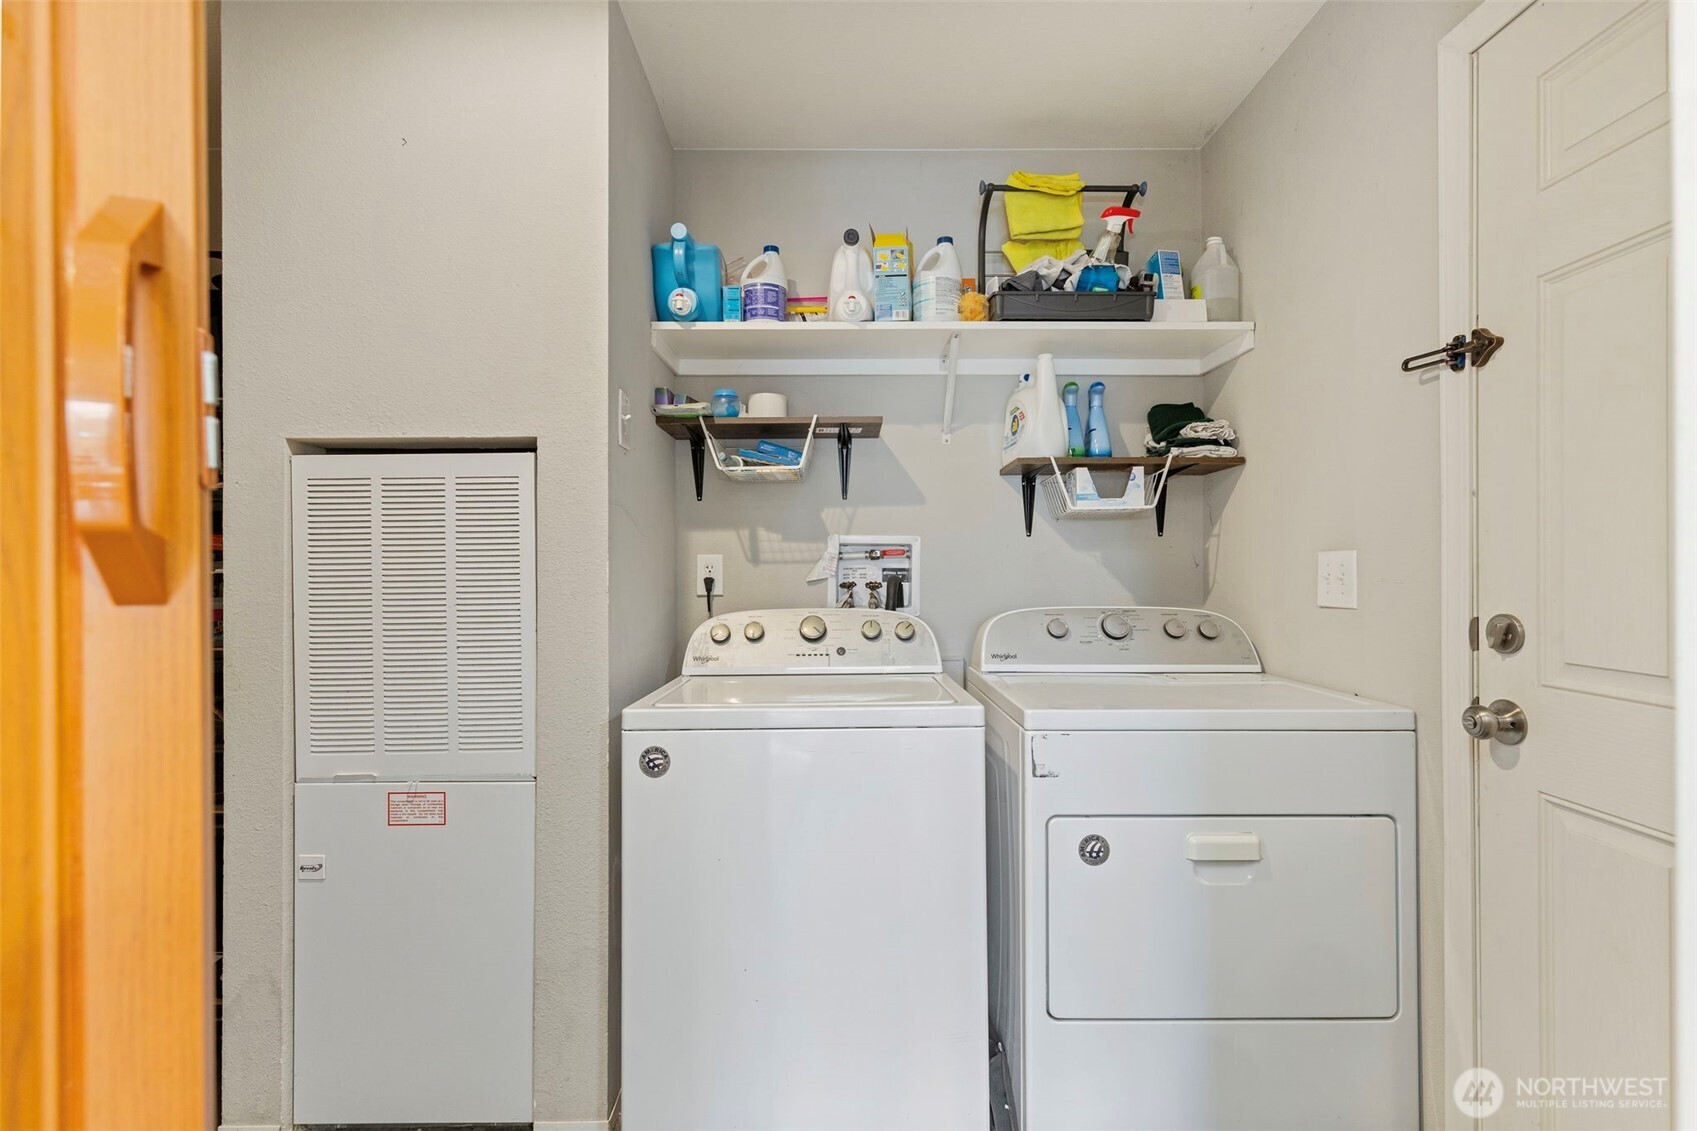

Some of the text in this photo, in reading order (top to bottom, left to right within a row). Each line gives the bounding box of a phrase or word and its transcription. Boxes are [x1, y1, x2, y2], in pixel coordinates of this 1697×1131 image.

[692, 655, 720, 665] Whirlpool
[990, 653, 1017, 662] Whirlpool
[641, 747, 668, 760] AMRICA
[1080, 835, 1100, 858] AMRICA
